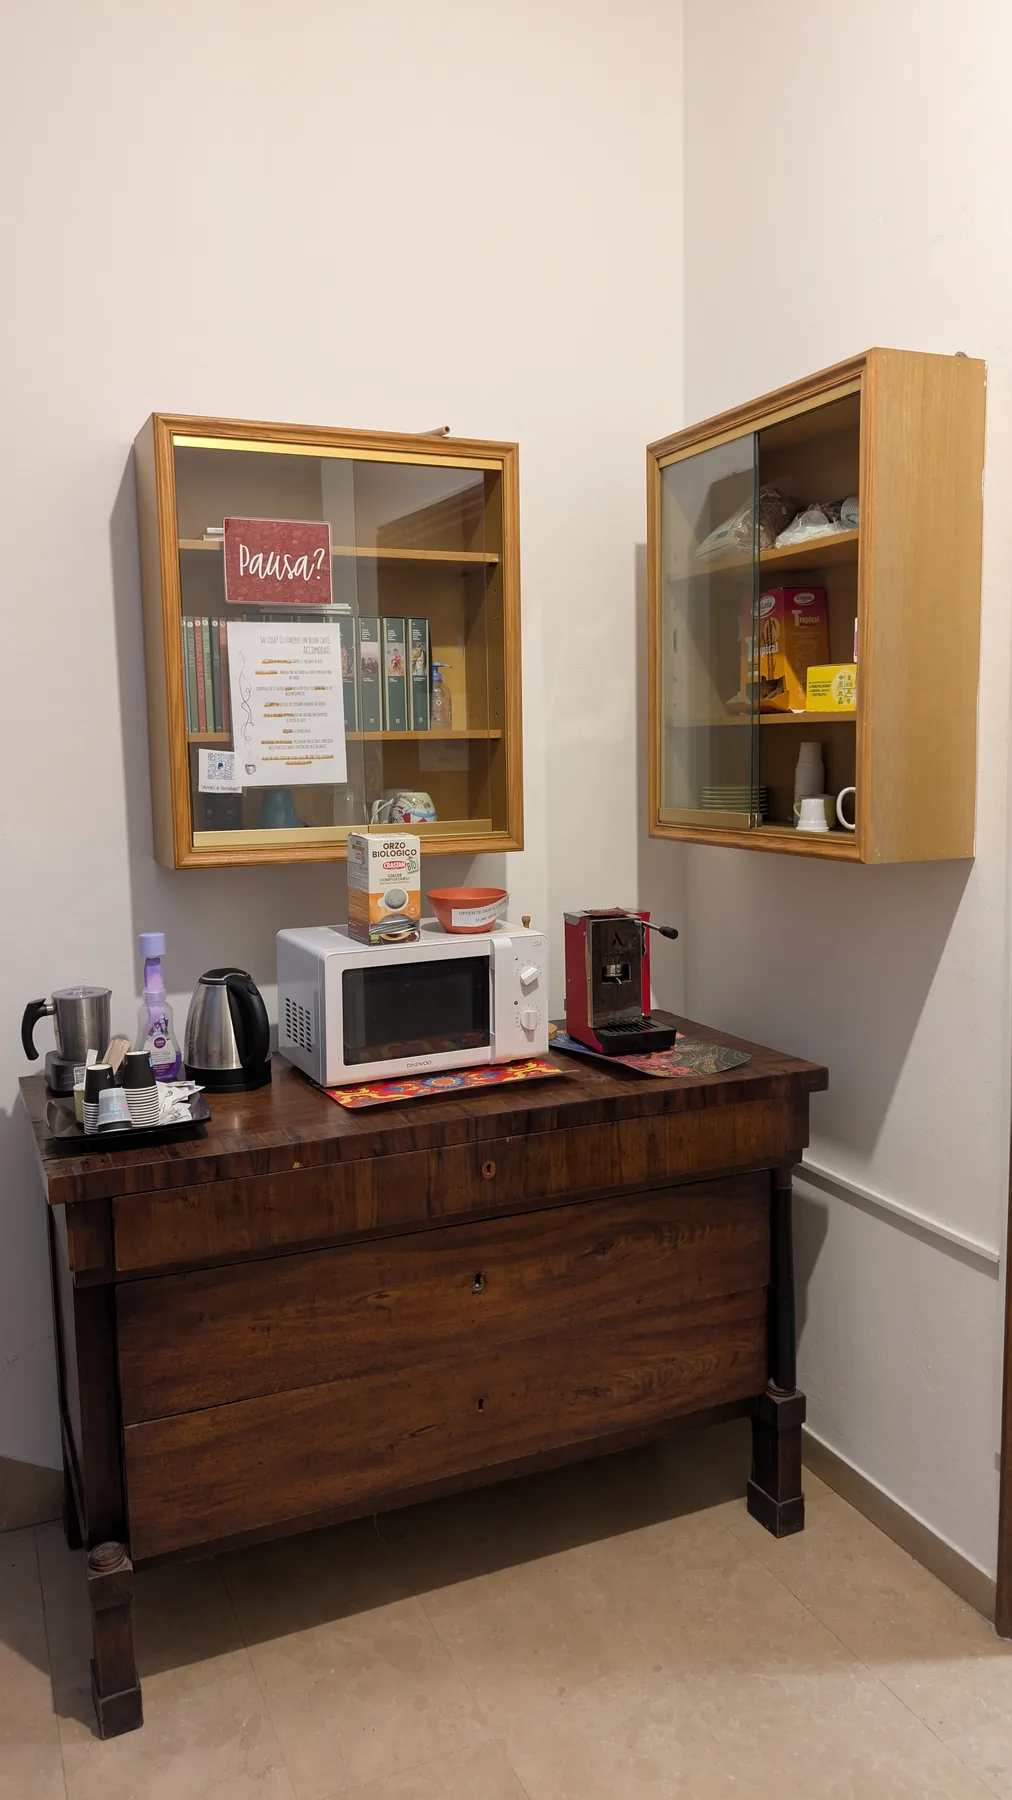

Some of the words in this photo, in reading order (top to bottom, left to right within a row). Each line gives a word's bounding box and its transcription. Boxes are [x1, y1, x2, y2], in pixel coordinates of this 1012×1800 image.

[239, 543, 326, 582] Pausa?
[791, 609, 821, 627] Tropical
[383, 841, 406, 850] ORZO
[372, 849, 417, 858] BIOLOGICO
[383, 861, 406, 869] CRASTAN
[406, 1060, 432, 1068] DAEWOO
